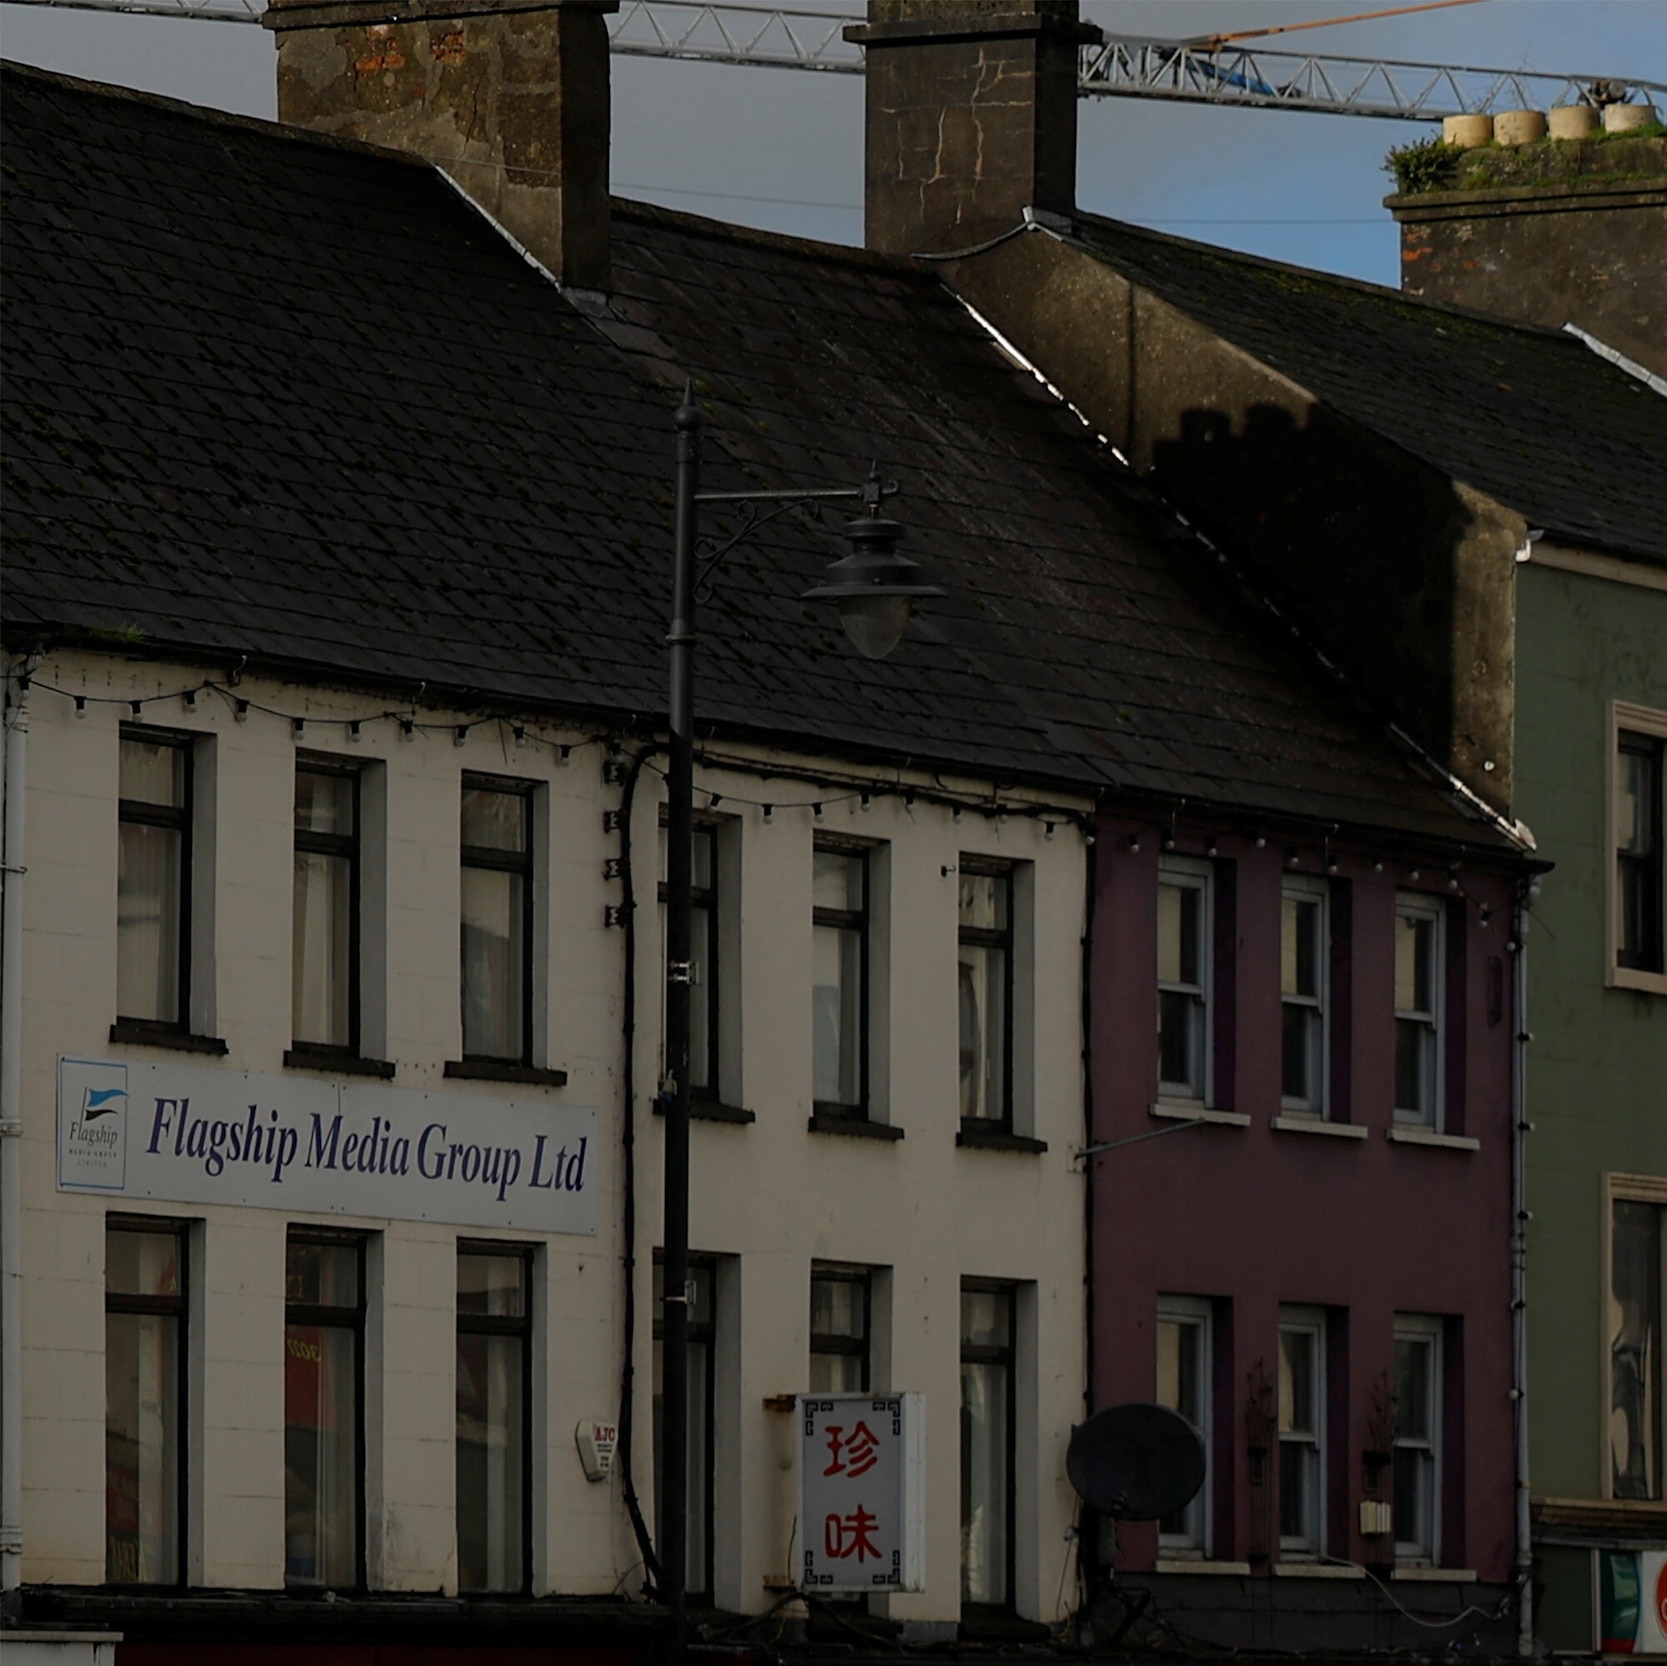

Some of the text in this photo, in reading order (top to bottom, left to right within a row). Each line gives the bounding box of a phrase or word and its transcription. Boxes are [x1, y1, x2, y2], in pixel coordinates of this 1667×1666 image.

[70, 1122, 118, 1150] Flagship
[146, 1097, 588, 1201] Flagship Media Group Ltd
[822, 1420, 885, 1566] 珍味
